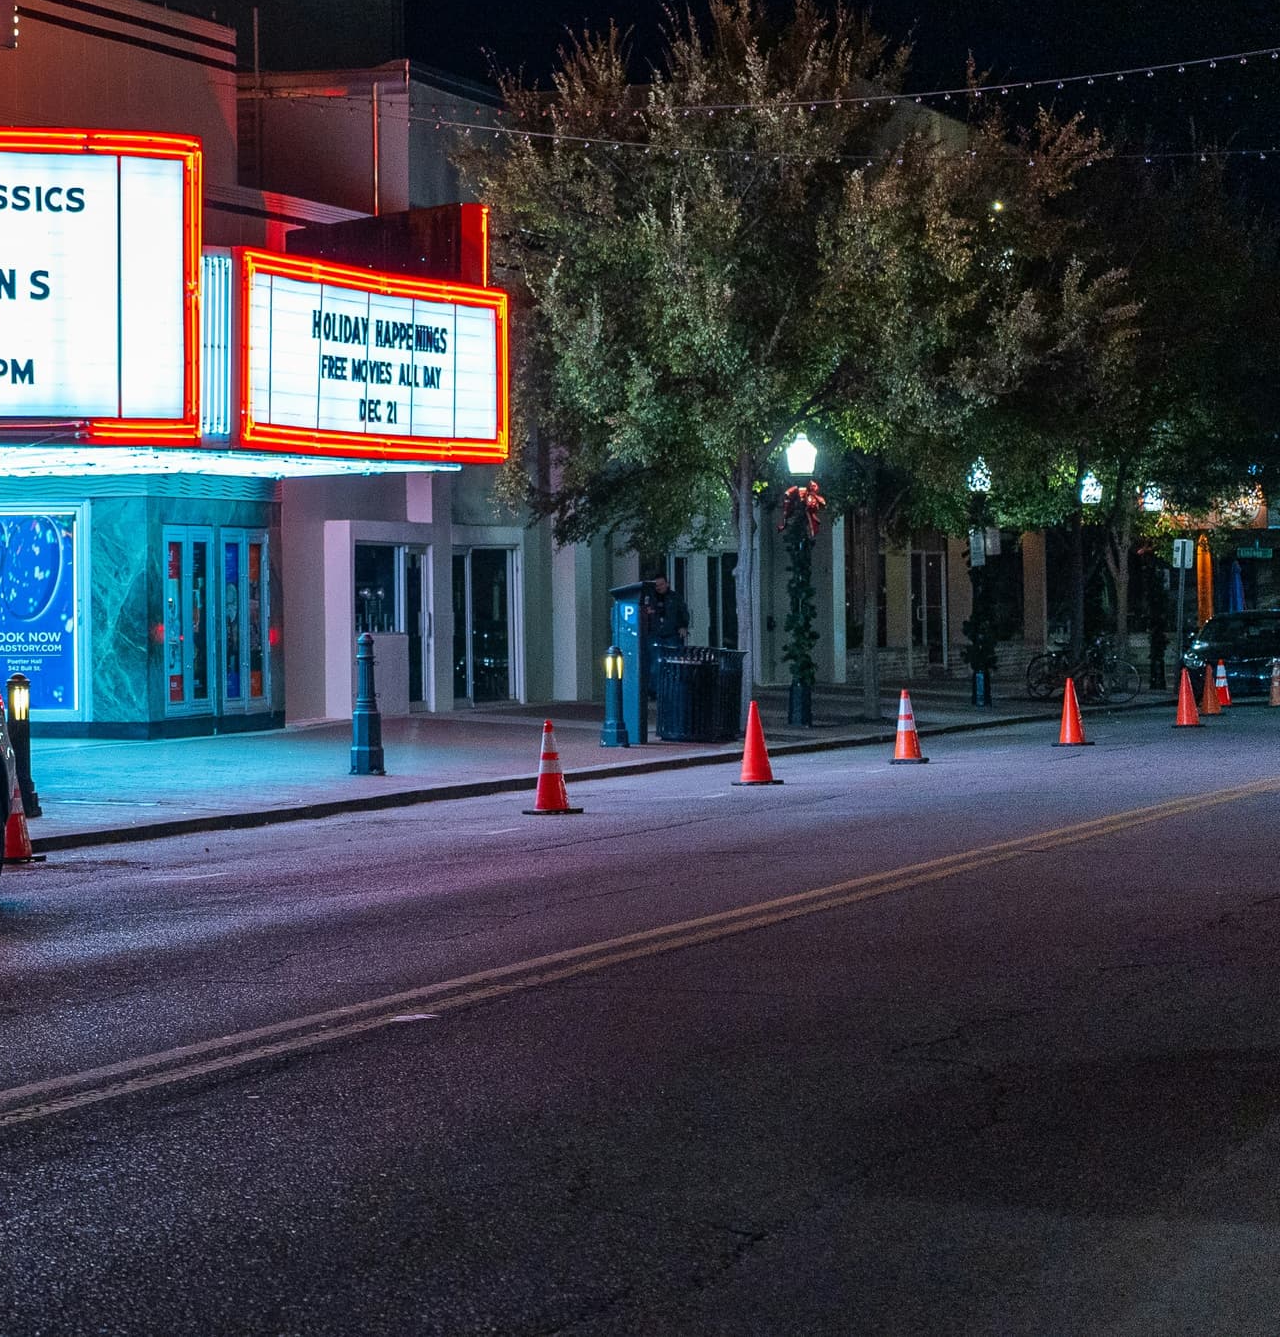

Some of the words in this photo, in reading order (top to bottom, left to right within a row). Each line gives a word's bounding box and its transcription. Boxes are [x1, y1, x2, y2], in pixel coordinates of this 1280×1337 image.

[312, 309, 369, 346] HOLIDAY
[375, 319, 448, 354] HAPPENINGS
[321, 355, 348, 381] FREE
[351, 358, 393, 385] MOVIES
[398, 363, 420, 389] ALL
[423, 365, 442, 390] DAY
[359, 398, 382, 423] DEC
[386, 400, 398, 424] 21
[624, 605, 635, 622] P
[28, 632, 62, 643] NOW
